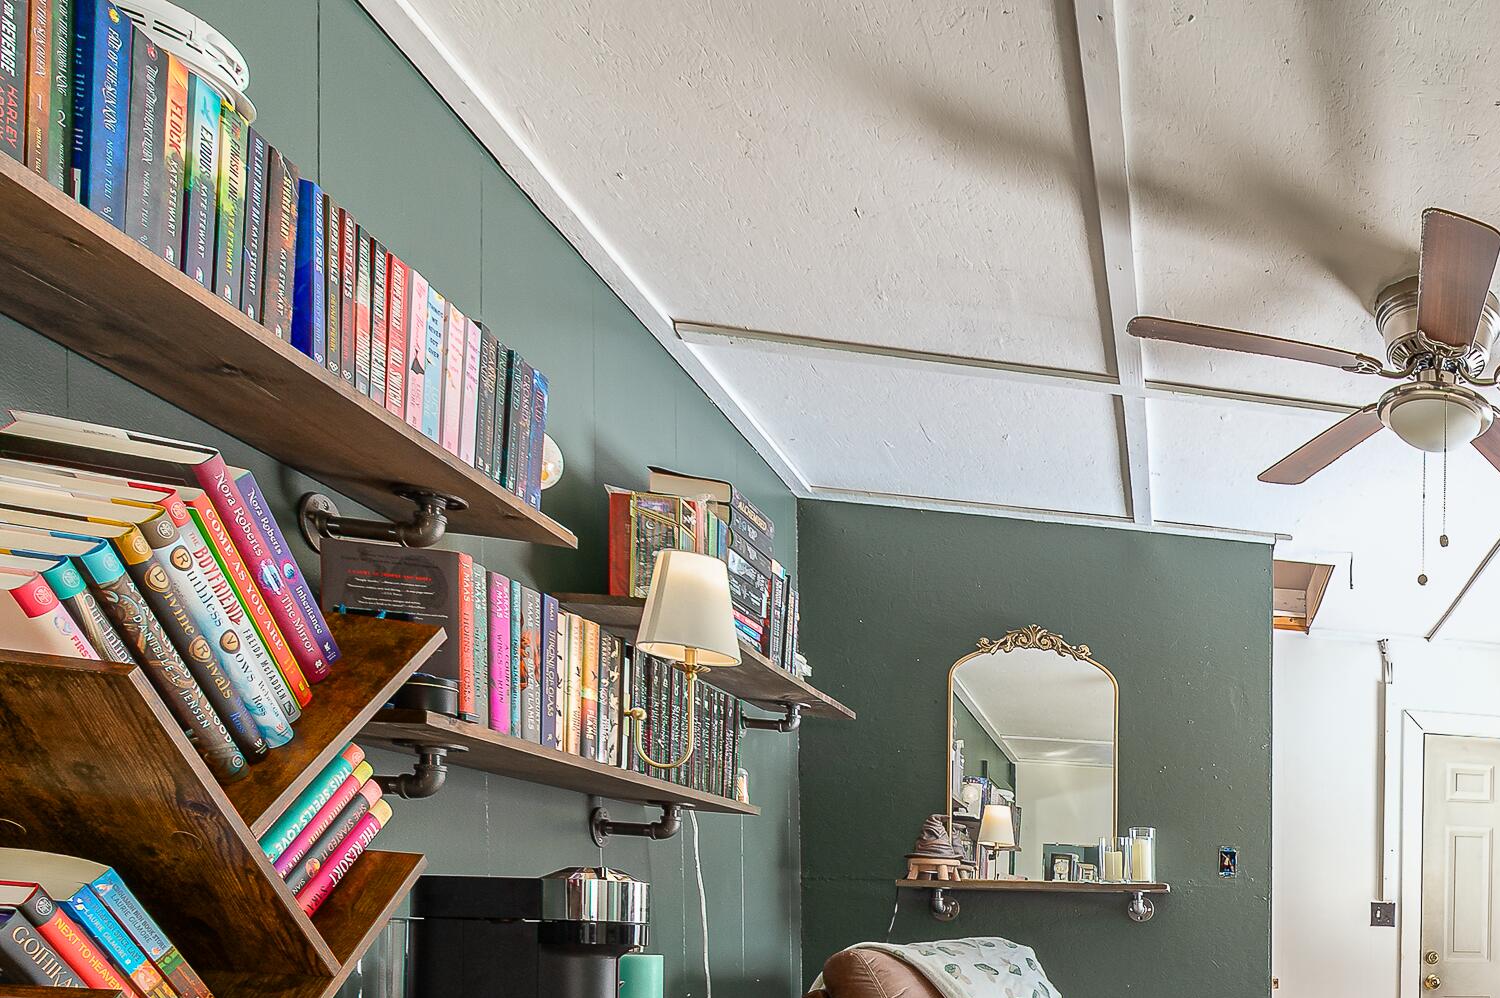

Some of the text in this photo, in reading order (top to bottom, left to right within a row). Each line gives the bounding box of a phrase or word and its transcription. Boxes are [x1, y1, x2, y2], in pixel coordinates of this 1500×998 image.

[1, 15, 17, 77] REVENGE
[6, 84, 18, 148] HARLEY
[101, 106, 117, 134] KING
[167, 99, 183, 155] FLOCK
[105, 140, 114, 199] NISHA TULI
[199, 124, 214, 179] EXODUS
[229, 140, 241, 177] FINISH
[166, 159, 179, 237] KATE STEWART
[227, 176, 239, 201] LINE
[248, 138, 264, 295] ONE LAST RAINY DAY KATE STEWART
[198, 182, 208, 258] KATE STEWART
[280, 214, 291, 240] HEART
[315, 193, 323, 274] INDIGO RIDGE
[330, 206, 339, 285] JASPER VALE
[225, 227, 236, 276] STEWART
[343, 217, 354, 299] GARNET FLATS
[277, 248, 288, 315] KATE STEWART
[371, 339, 387, 392] HIDEAWAY
[389, 367, 405, 407] SWITCH
[513, 367, 522, 410] TWISTED
[520, 373, 531, 423] CROSSED
[214, 471, 264, 557] Nora Roberts
[248, 487, 283, 555] Nora Roberts
[188, 531, 246, 625] THE BOYFRIEND
[205, 508, 284, 651] COME AS YOU ARE
[463, 570, 472, 601] MAAS
[84, 593, 105, 625] Our
[147, 566, 233, 700] Divine Rivals
[173, 548, 224, 629] Ruthless
[221, 629, 256, 682] Vows
[280, 593, 316, 654] The Mirror
[296, 585, 324, 635] Inheritance
[132, 614, 175, 673] DANIELLE
[179, 689, 211, 729] JENSEN
[138, 597, 161, 632] FATE
[203, 702, 233, 743] BLOOD
[243, 628, 287, 702] FREIDA McFADDEN
[251, 694, 268, 718] Ross
[331, 766, 351, 789] THIS
[299, 788, 332, 825] SPELLS
[353, 803, 367, 820] SHE
[275, 821, 301, 855] LOVE
[328, 818, 355, 852] STARTED
[328, 822, 381, 888] THE RESORT
[291, 878, 306, 895] SIAN
[83, 908, 127, 959] LAURIE GILMORE
[110, 893, 152, 943] LAURIE GILMORE
[54, 917, 123, 989] NEXT TO HEAVEN
